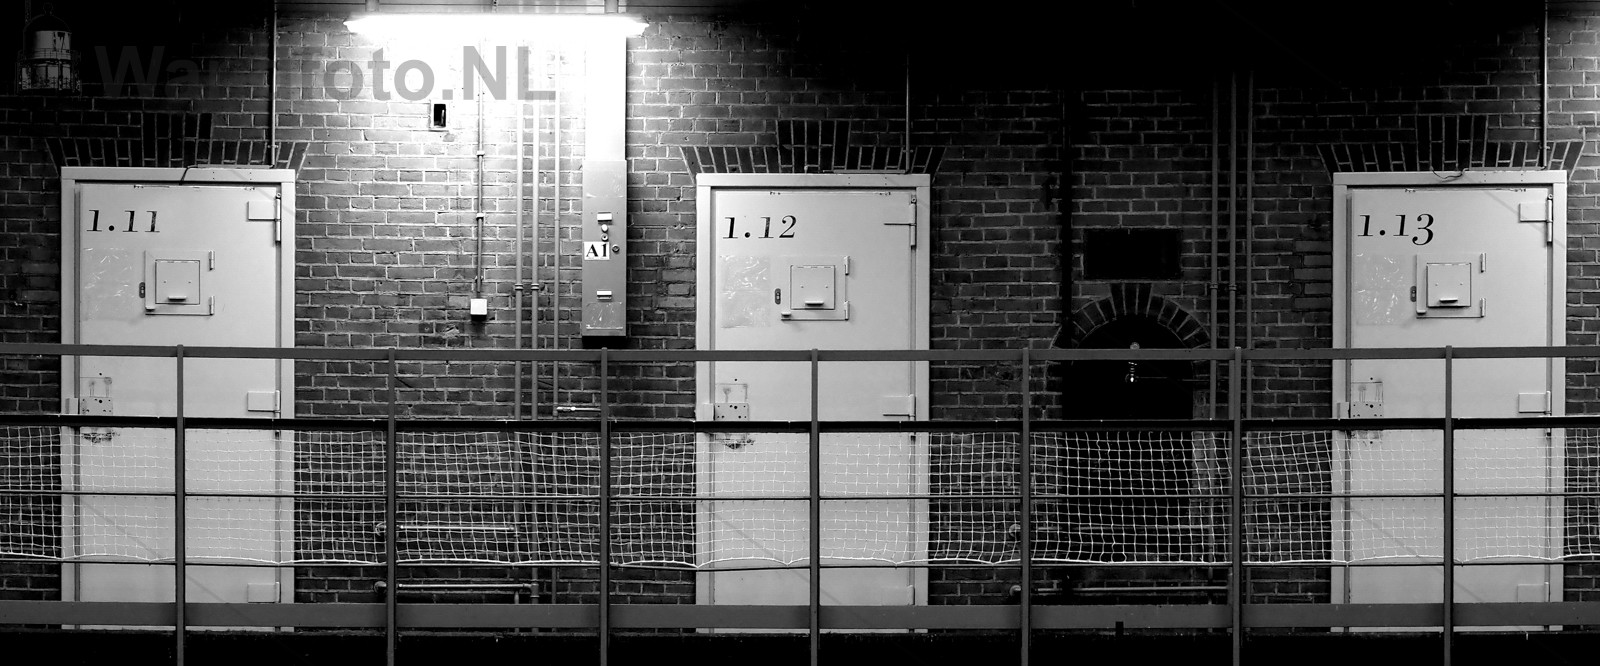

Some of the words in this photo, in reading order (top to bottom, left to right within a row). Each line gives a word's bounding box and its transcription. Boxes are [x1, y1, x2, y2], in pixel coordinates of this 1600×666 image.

[87, 209, 160, 233] 1.11
[723, 215, 798, 239] 1.12
[1357, 213, 1435, 246] 1.13
[585, 243, 608, 257] A1
